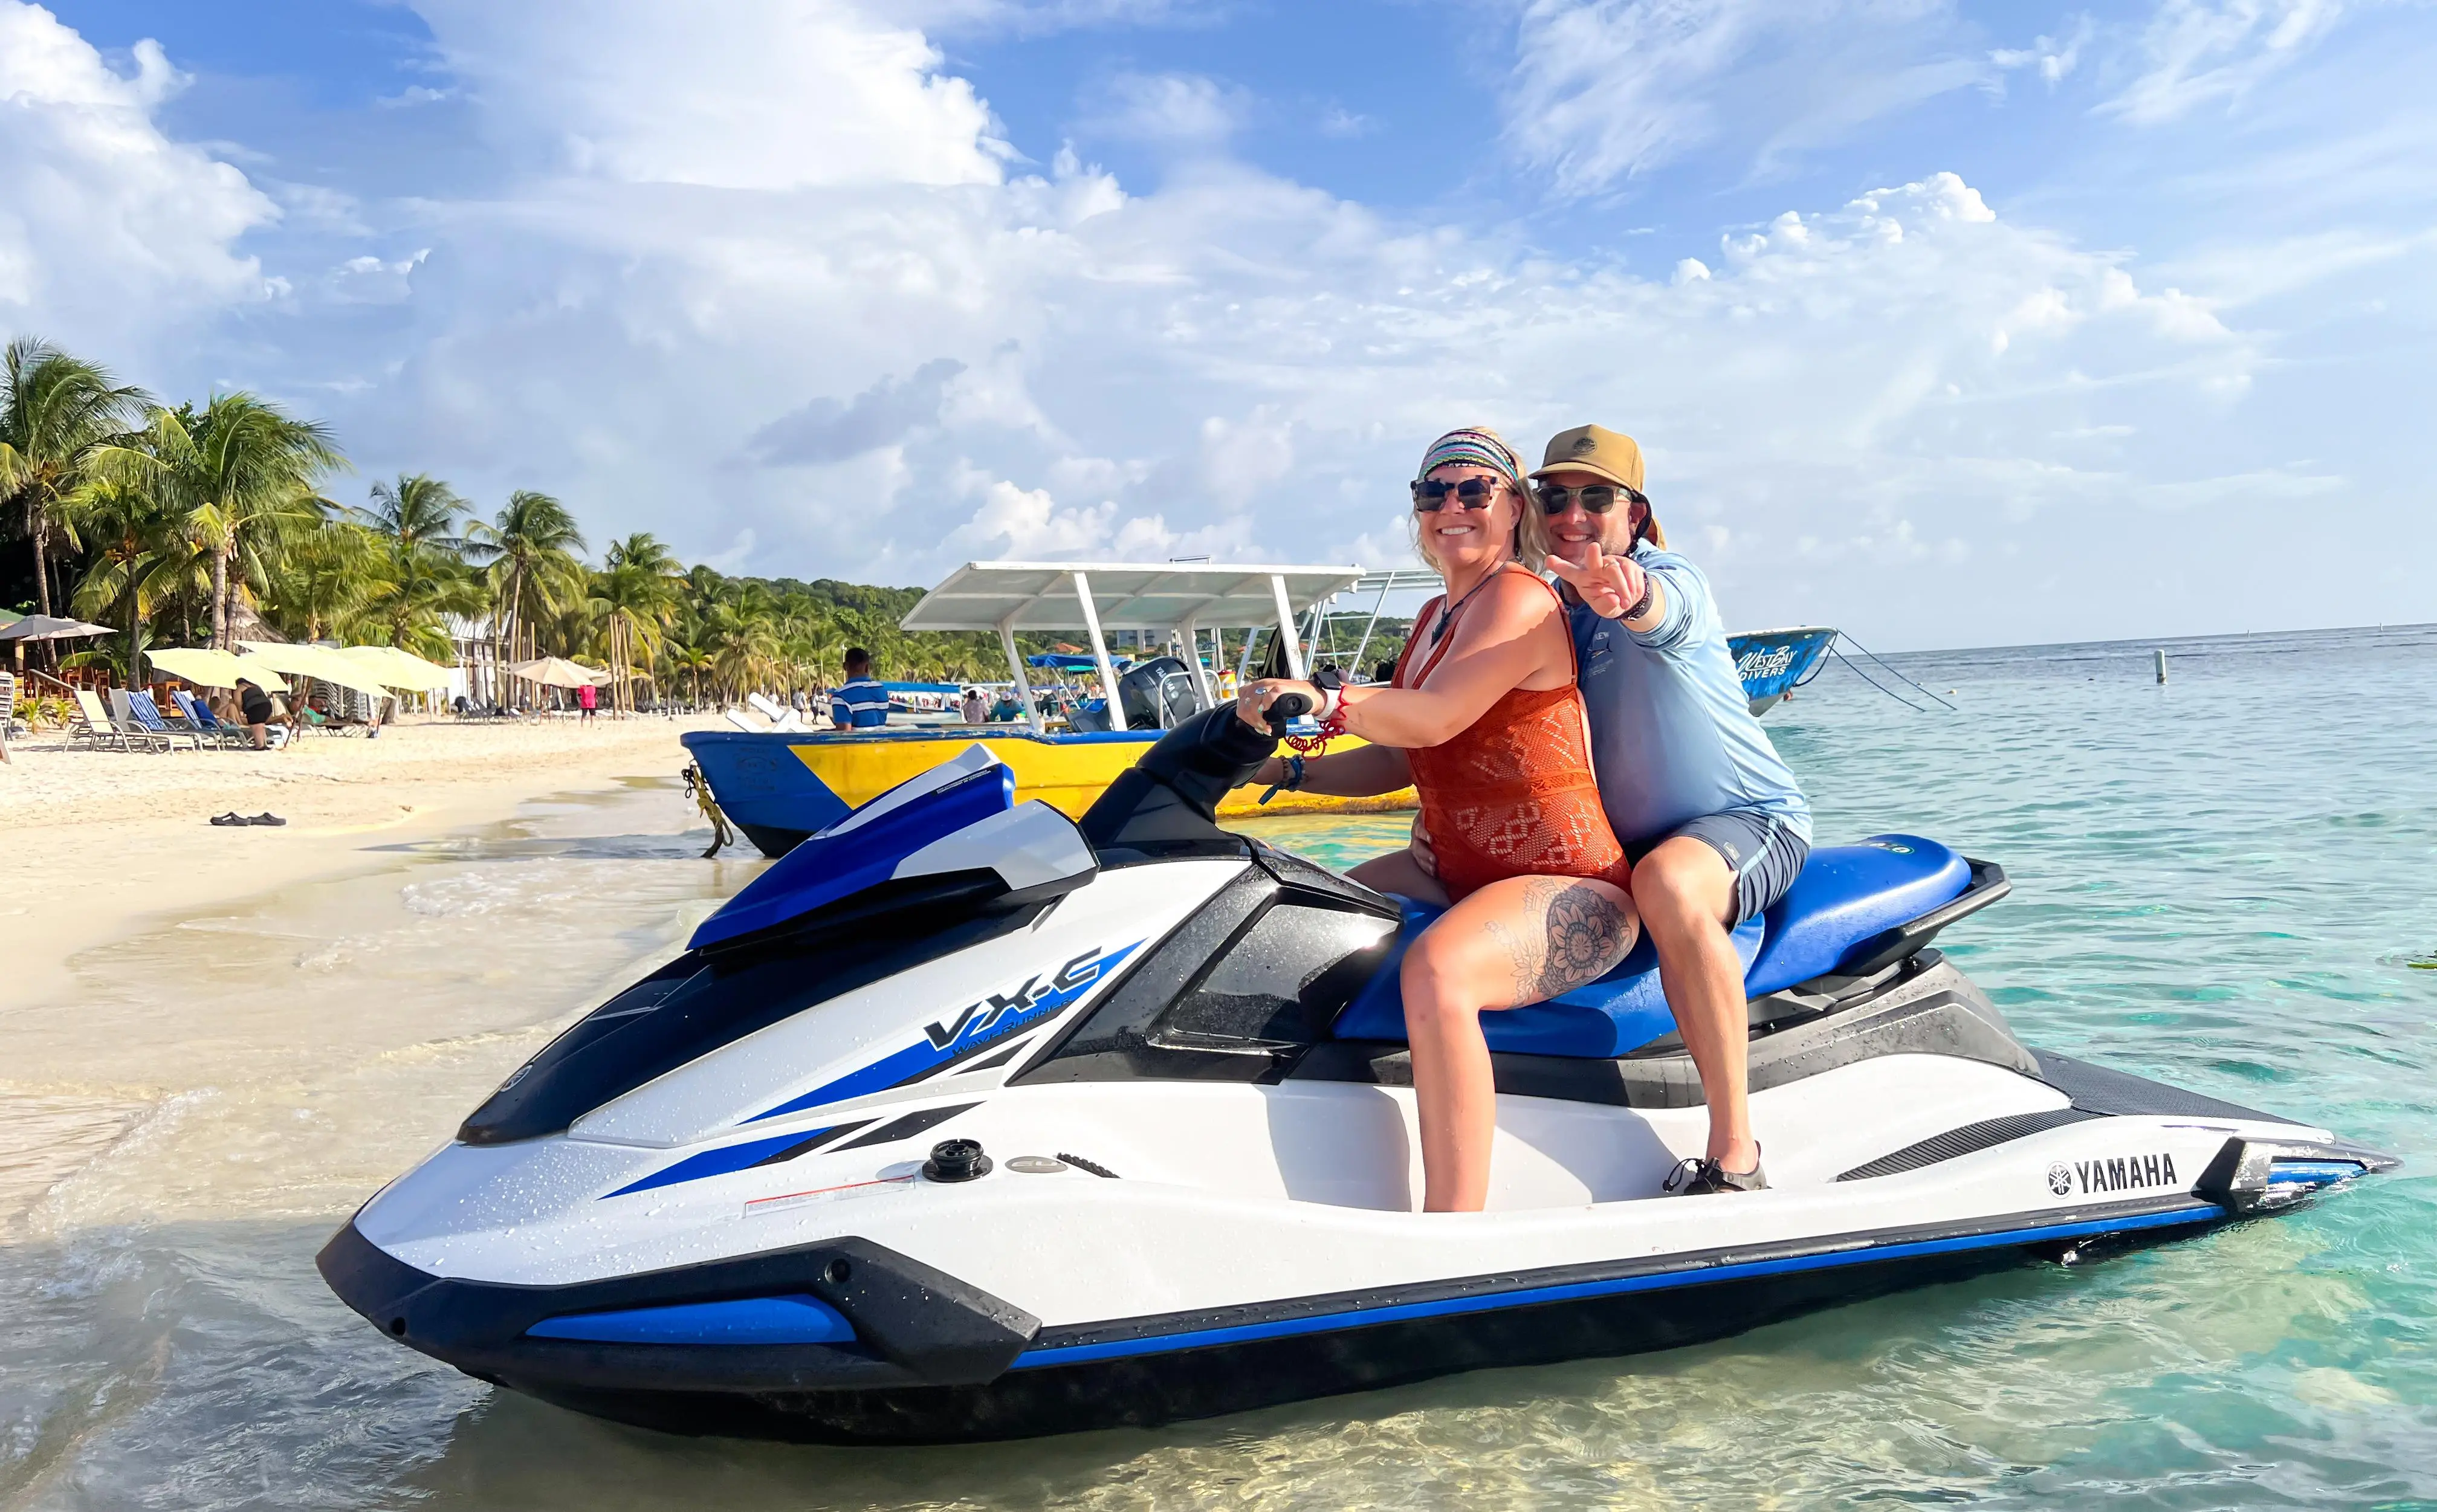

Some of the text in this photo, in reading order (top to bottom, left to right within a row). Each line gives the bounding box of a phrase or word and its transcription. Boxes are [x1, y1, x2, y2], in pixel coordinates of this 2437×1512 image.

[1740, 666, 1786, 681] DIVERS
[922, 945, 1102, 1050] VX-C
[951, 997, 1075, 1057] WAVERUNNER
[2074, 1153, 2177, 1194] YAMAHA
